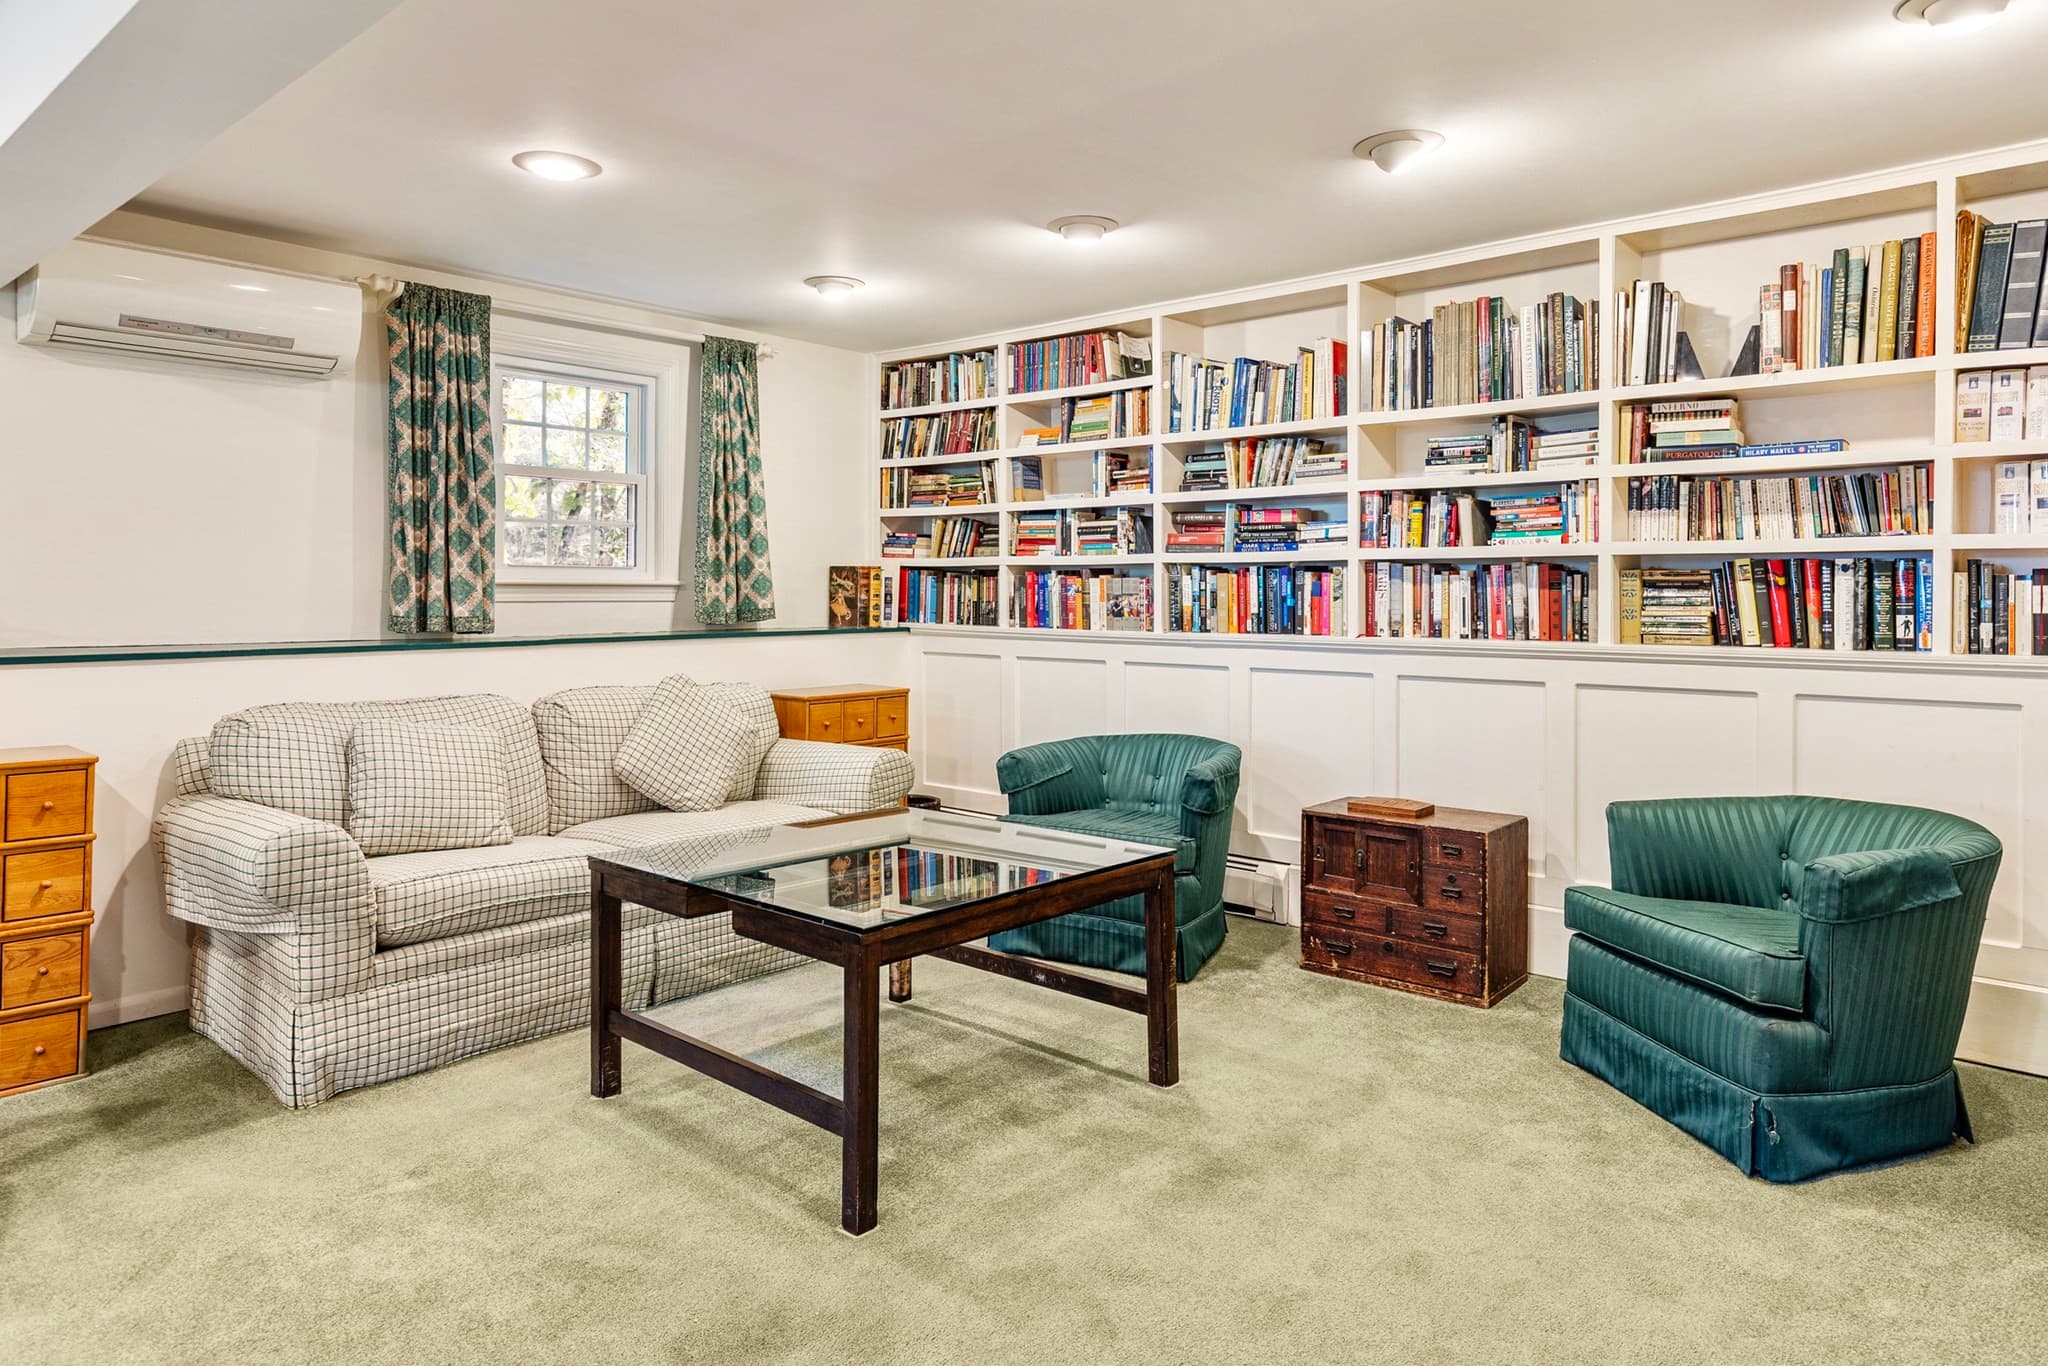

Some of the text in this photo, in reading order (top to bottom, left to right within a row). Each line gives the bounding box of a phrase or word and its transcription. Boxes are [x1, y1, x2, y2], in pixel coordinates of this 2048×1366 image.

[1887, 254, 1897, 291] SYRACUSE
[1885, 294, 1895, 338] UNIVERSITY
[1211, 386, 1221, 415] KNOTS
[1657, 403, 1699, 412] INFERNO
[1665, 449, 1721, 459] PURGATORIO
[1770, 446, 1796, 455] MANTEL
